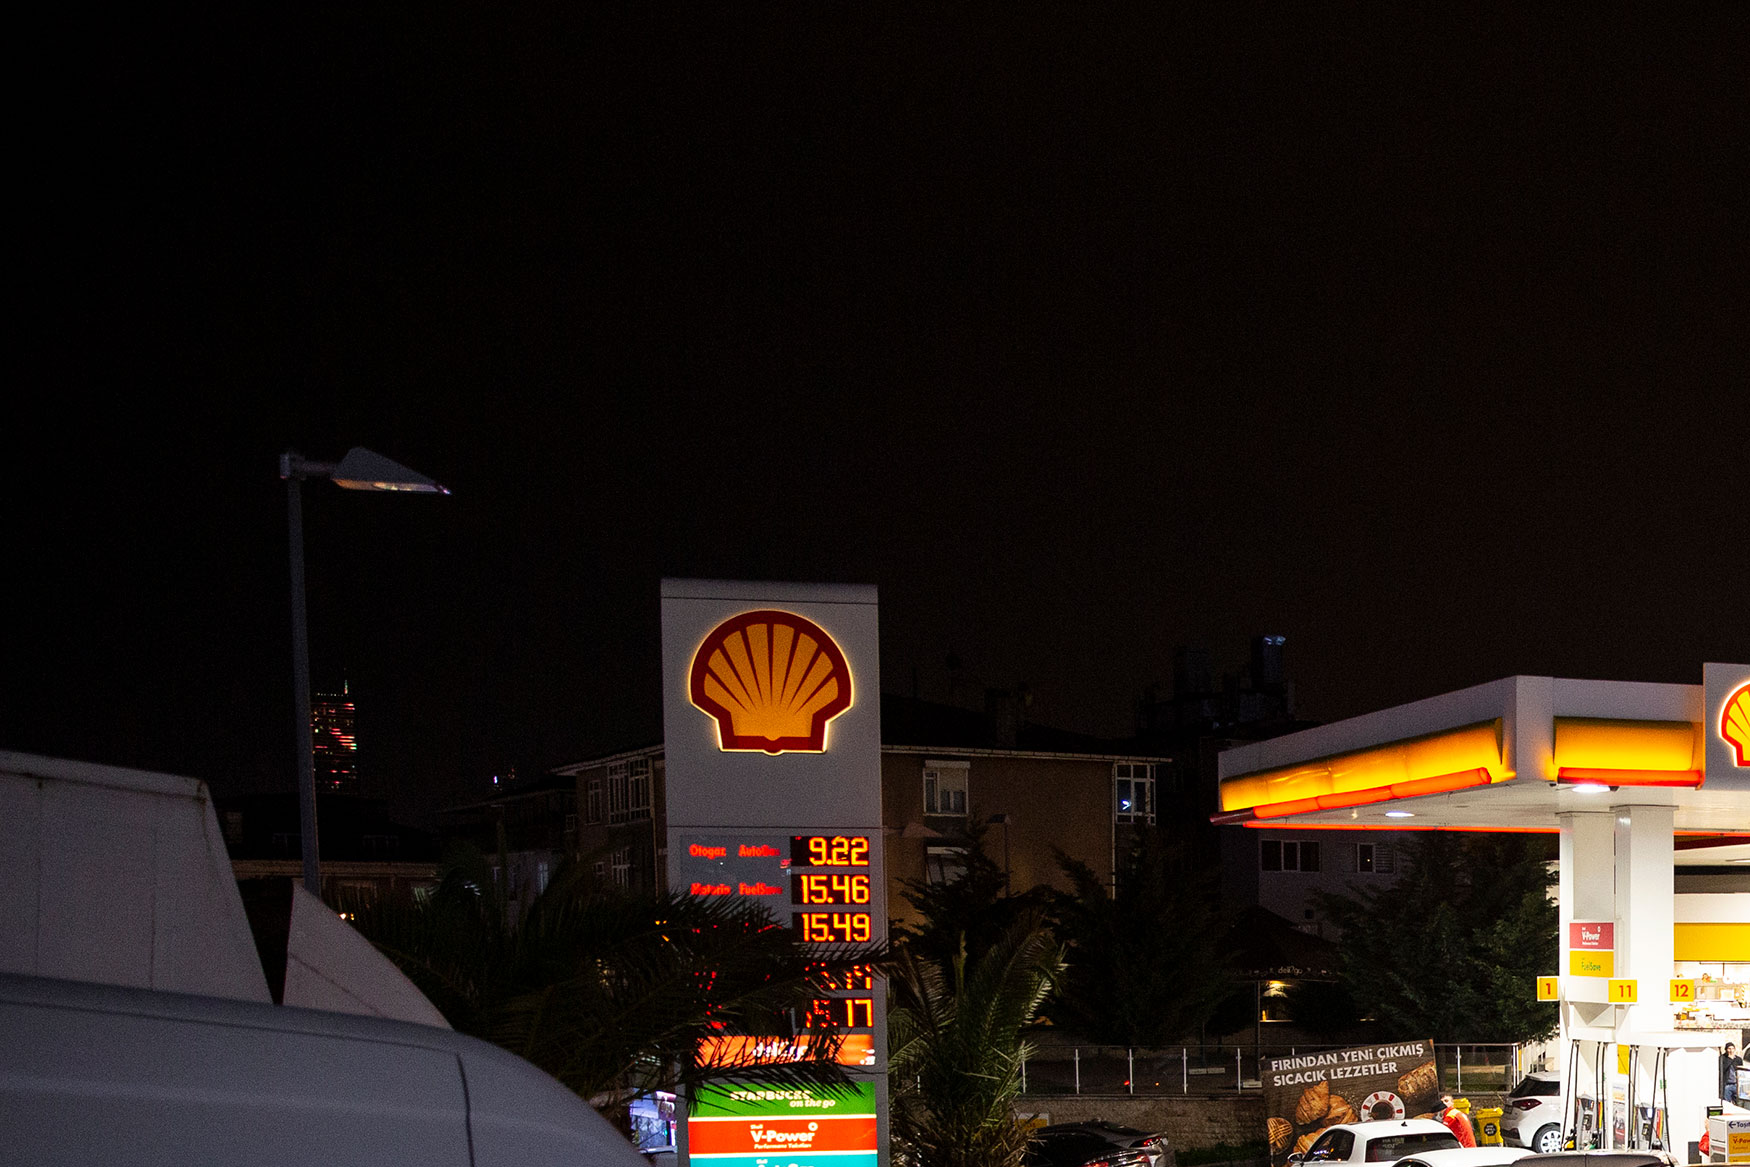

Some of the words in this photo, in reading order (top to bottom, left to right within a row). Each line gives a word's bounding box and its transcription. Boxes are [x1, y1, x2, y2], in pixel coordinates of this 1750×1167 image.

[808, 836, 870, 866] 9.22
[800, 874, 870, 904] 15.46
[801, 913, 872, 942] 15.49
[1545, 983, 1551, 995] 1
[1618, 985, 1632, 997] 11
[1674, 984, 1689, 997] 12
[1271, 1053, 1339, 1072] FIRINDAN
[1376, 1043, 1424, 1062] ÇIKMIŞ
[1273, 1070, 1327, 1087] SICACIK
[1330, 1062, 1398, 1080] LEZZETLER
[729, 1090, 812, 1101] STARBUCKS
[804, 1099, 822, 1108] the
[822, 1100, 836, 1109] go
[750, 1130, 815, 1143] V-Power
